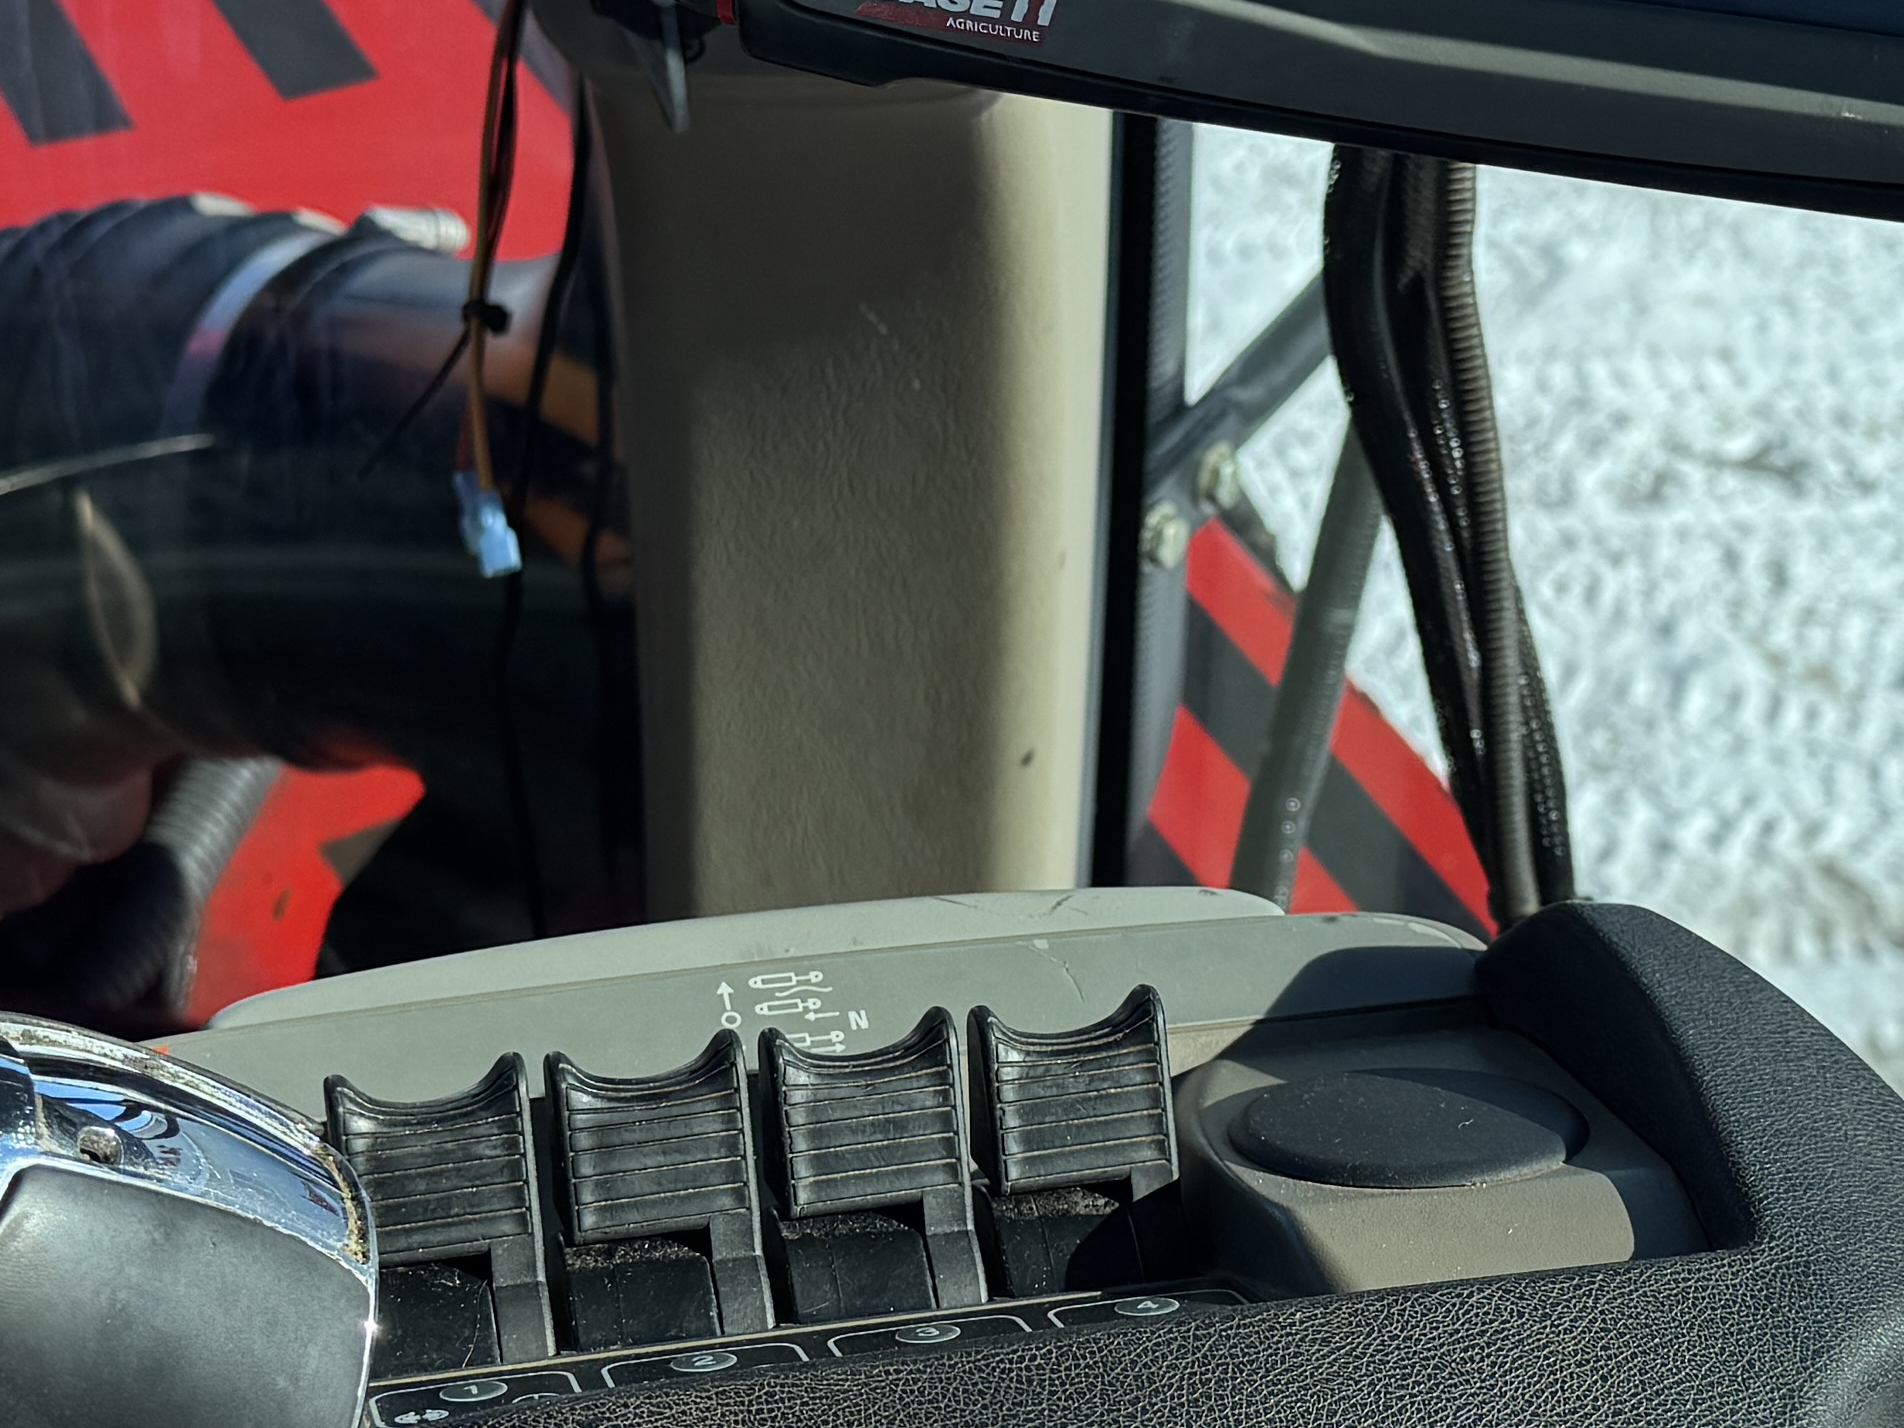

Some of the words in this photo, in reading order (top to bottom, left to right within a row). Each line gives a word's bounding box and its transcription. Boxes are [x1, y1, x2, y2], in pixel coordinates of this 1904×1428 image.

[946, 17, 1041, 43] AGRICULTURE
[848, 1010, 869, 1031] N
[1137, 1300, 1160, 1309] 4
[916, 1327, 940, 1337] 3
[692, 1355, 716, 1366] 2
